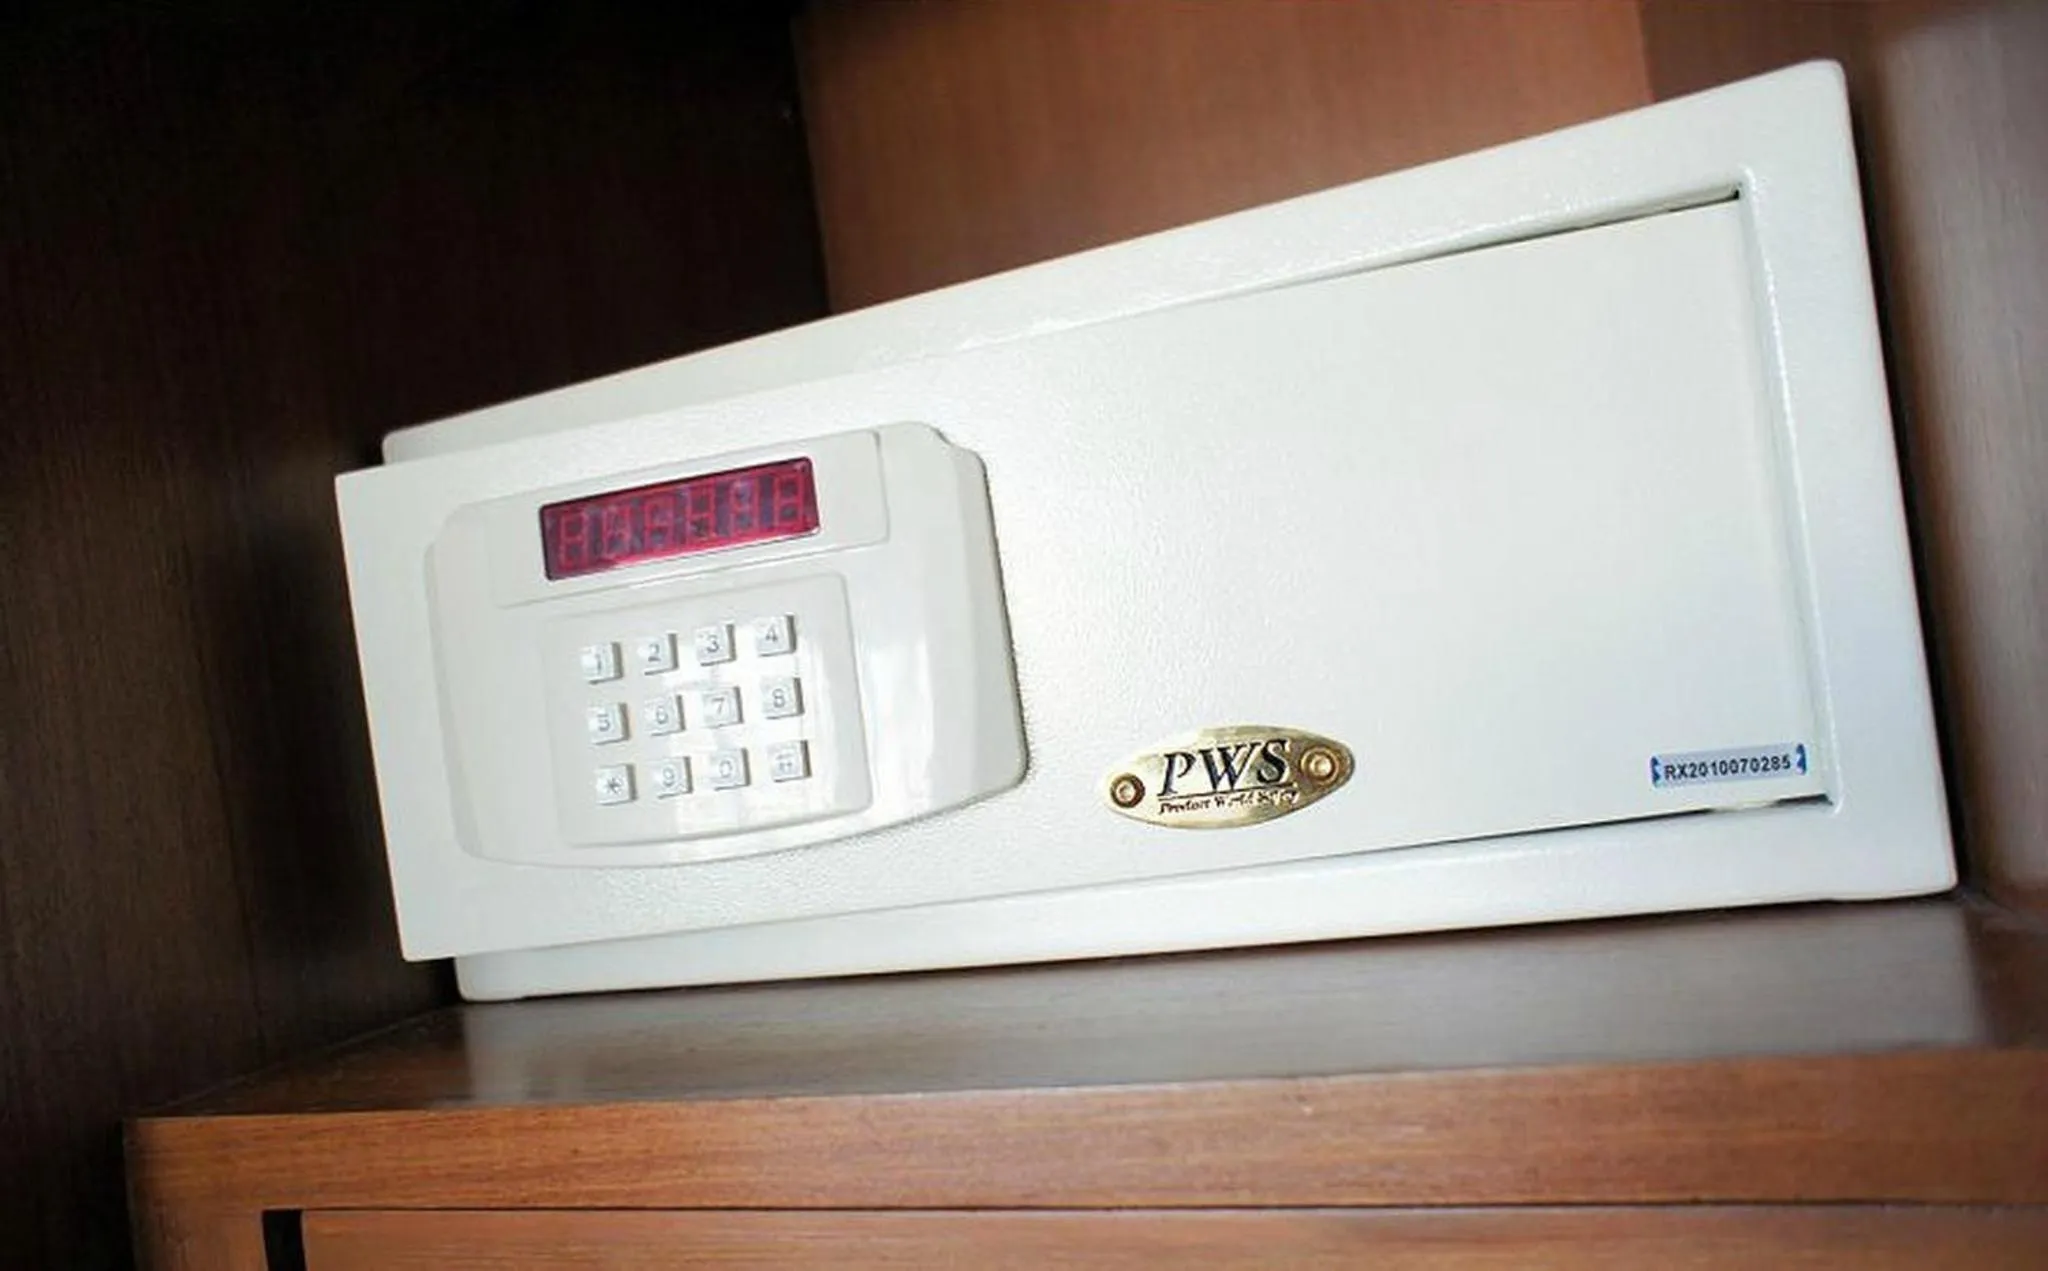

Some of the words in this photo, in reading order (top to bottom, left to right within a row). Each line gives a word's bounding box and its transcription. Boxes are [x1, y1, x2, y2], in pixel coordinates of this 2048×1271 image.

[647, 643, 661, 662] 2
[706, 634, 720, 653] 3
[765, 625, 779, 643] 4
[597, 713, 611, 732] 5
[655, 706, 669, 725] 6
[711, 697, 725, 714] 7
[772, 688, 786, 708] 8
[662, 767, 676, 787] 9
[719, 760, 733, 778] 0
[1157, 738, 1289, 797] PWS
[1664, 754, 1792, 780] RX2010070285
